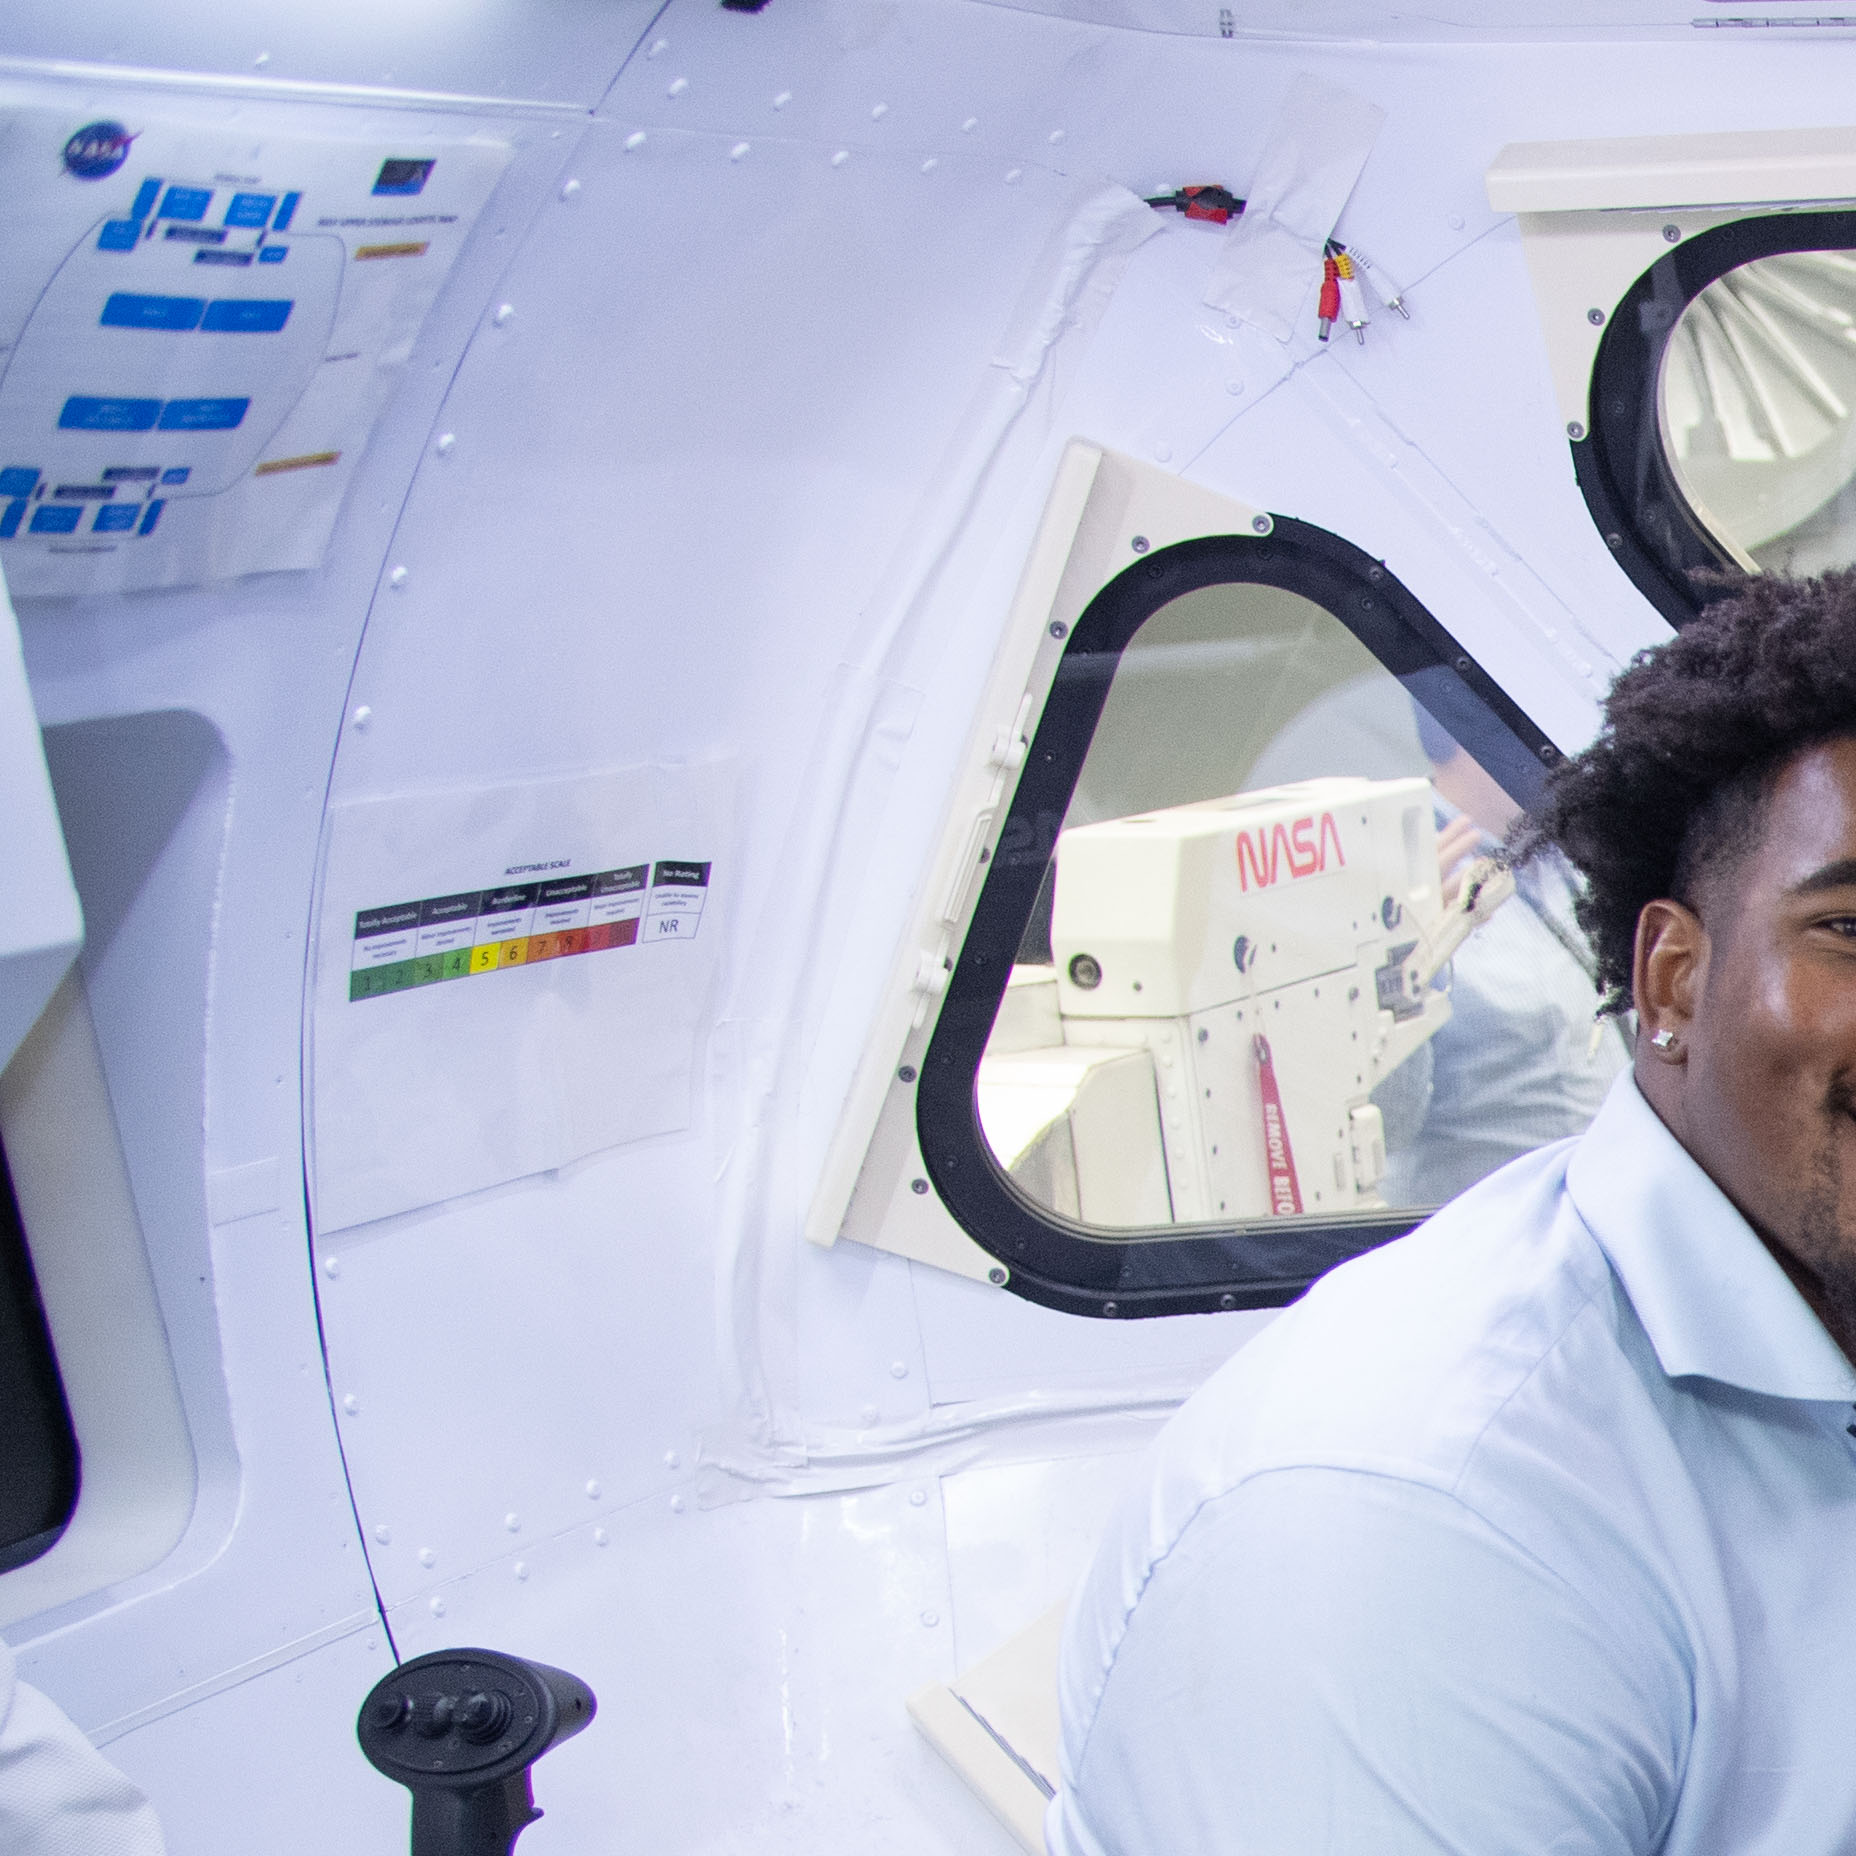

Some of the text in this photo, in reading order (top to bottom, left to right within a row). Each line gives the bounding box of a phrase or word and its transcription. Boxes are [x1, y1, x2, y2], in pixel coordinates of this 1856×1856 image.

[1236, 811, 1346, 893] NASA
[659, 919, 680, 933] NR
[480, 951, 489, 967] 5
[509, 945, 518, 961] 6
[1264, 1103, 1289, 1169] REMOVE
